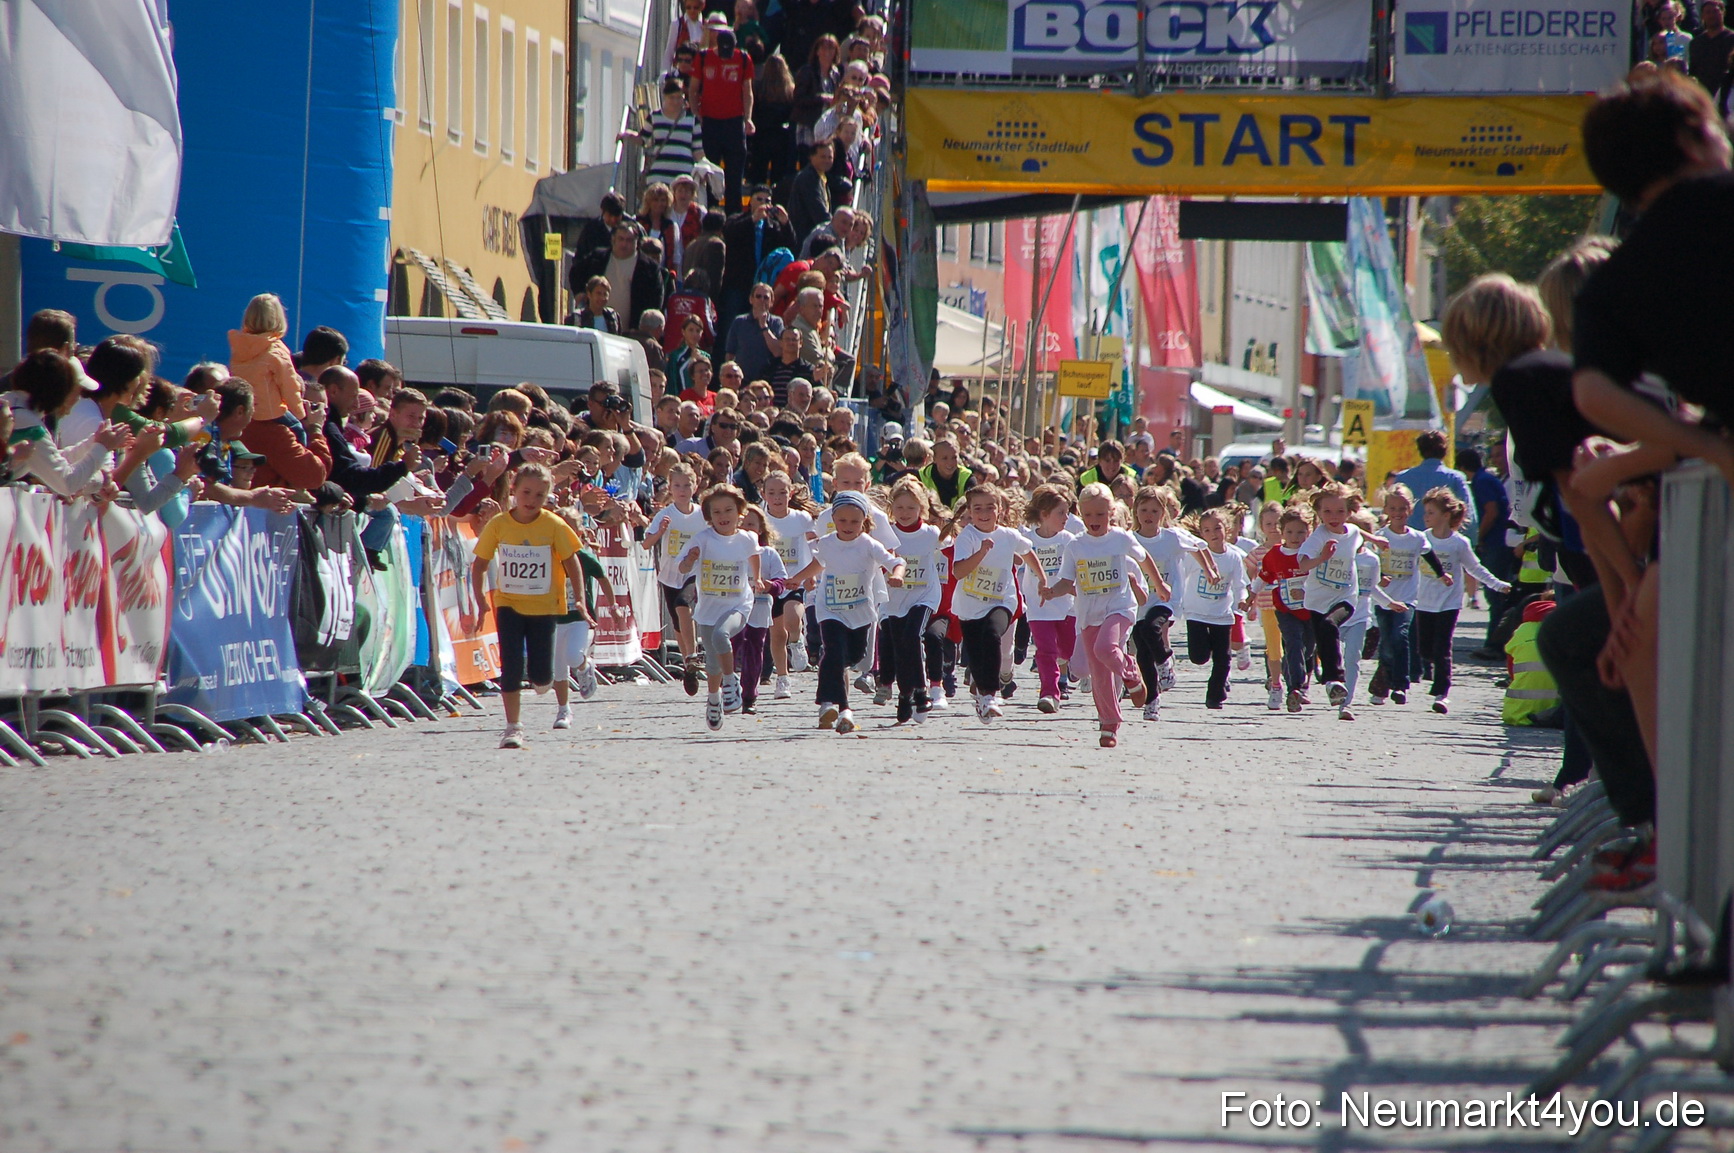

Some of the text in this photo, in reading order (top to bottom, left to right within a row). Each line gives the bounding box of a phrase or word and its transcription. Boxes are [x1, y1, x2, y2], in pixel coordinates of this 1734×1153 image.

[1014, 0, 1281, 53] BOCK
[1454, 11, 1617, 38] PFLEIDERER
[1453, 43, 1617, 57] AKTIENGESELLSCHAFT
[942, 138, 1090, 154] Neumarkter Stadtlauf
[1132, 113, 1371, 167] START
[1414, 143, 1568, 158] Neumarkter Stadtlauf
[1348, 414, 1366, 437] A
[501, 561, 546, 579] 10221
[1329, 558, 1344, 567] Emily
[712, 574, 741, 586] 7216
[905, 568, 925, 579] 217
[1090, 569, 1119, 582] 7056
[975, 577, 1004, 592] 7215
[837, 586, 865, 599] 7224
